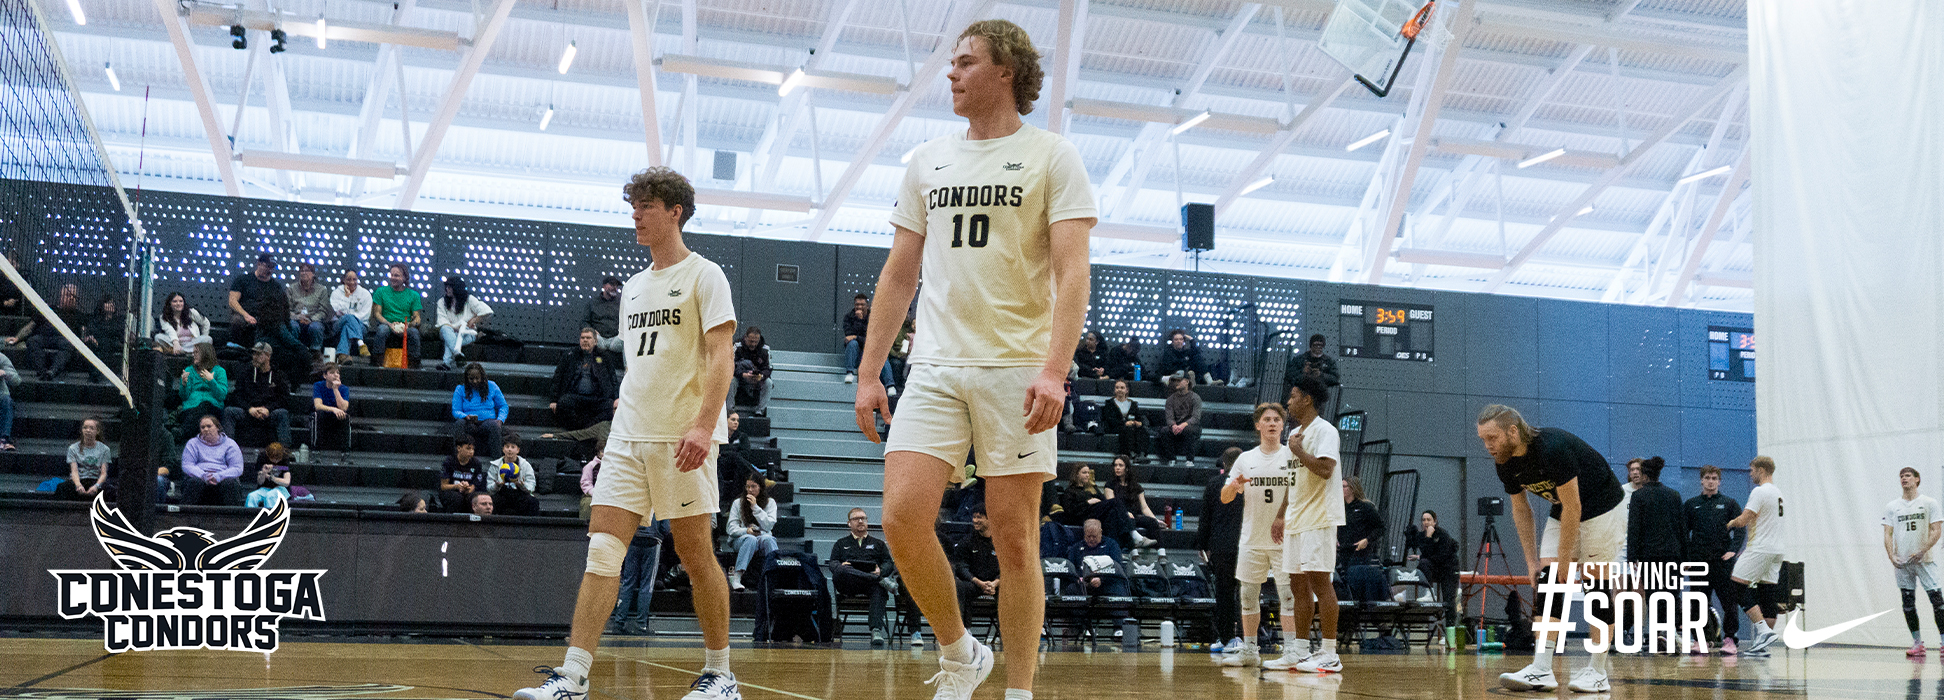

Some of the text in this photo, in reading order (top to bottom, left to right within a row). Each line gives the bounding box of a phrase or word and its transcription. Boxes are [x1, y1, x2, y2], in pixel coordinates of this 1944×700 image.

[929, 184, 1024, 210] CONDORS
[951, 213, 990, 248] 10
[1341, 304, 1363, 315] HOME
[1409, 309, 1433, 320] GUEST
[628, 308, 681, 331] CONDORS
[1376, 325, 1398, 335] PERIOD
[1709, 331, 1729, 341] HOME
[637, 331, 658, 357] 11
[1740, 334, 1755, 349] 3:5
[1250, 477, 1288, 486] CONDORS
[1264, 489, 1273, 503] 9
[1778, 497, 1784, 517] 6
[1906, 521, 1917, 531] 16
